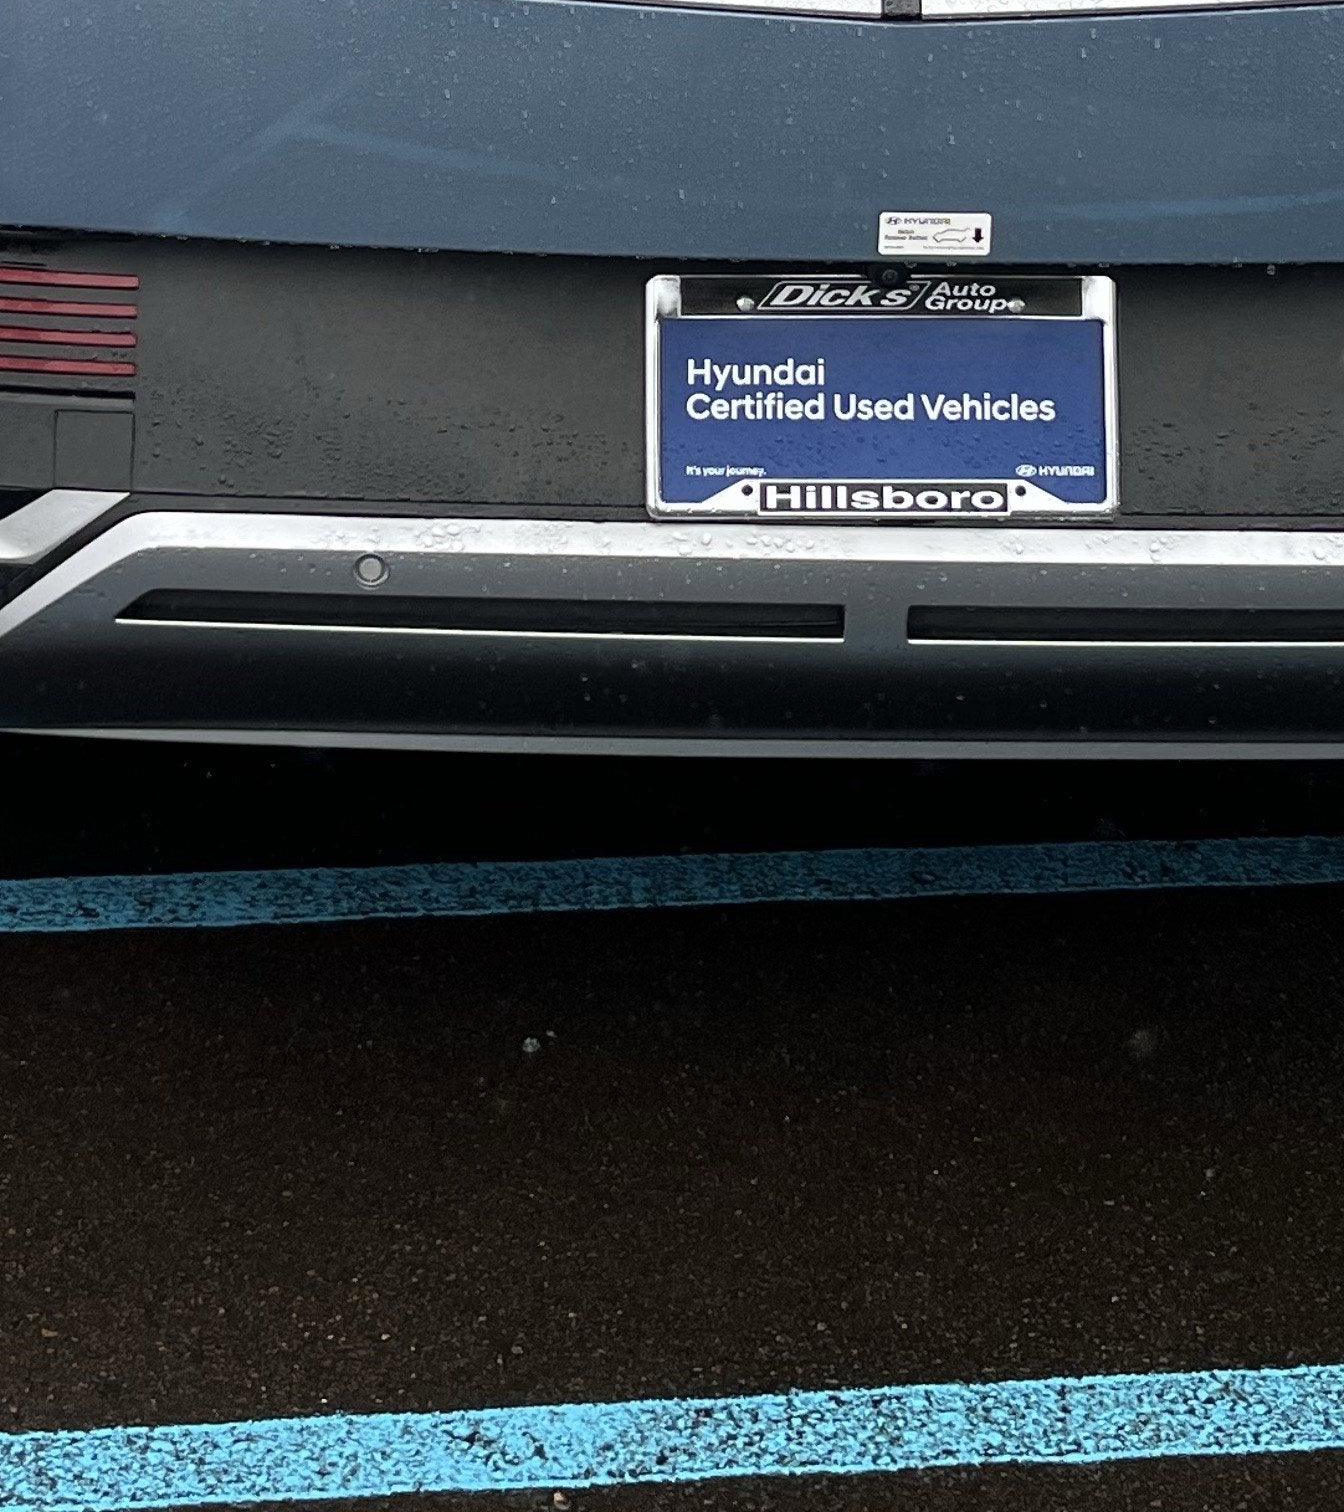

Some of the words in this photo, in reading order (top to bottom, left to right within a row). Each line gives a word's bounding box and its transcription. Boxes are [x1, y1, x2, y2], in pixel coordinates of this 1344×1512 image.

[932, 281, 997, 297] Auto
[925, 295, 1008, 313] Group
[687, 358, 825, 391] Hyundai
[686, 392, 825, 420] Certified
[833, 393, 914, 421] Used
[921, 392, 1056, 421] Vehicles
[686, 465, 701, 476] It's
[702, 467, 725, 477] your
[1038, 466, 1095, 476] HYUNDAI
[766, 485, 1004, 509] Hillsboro
